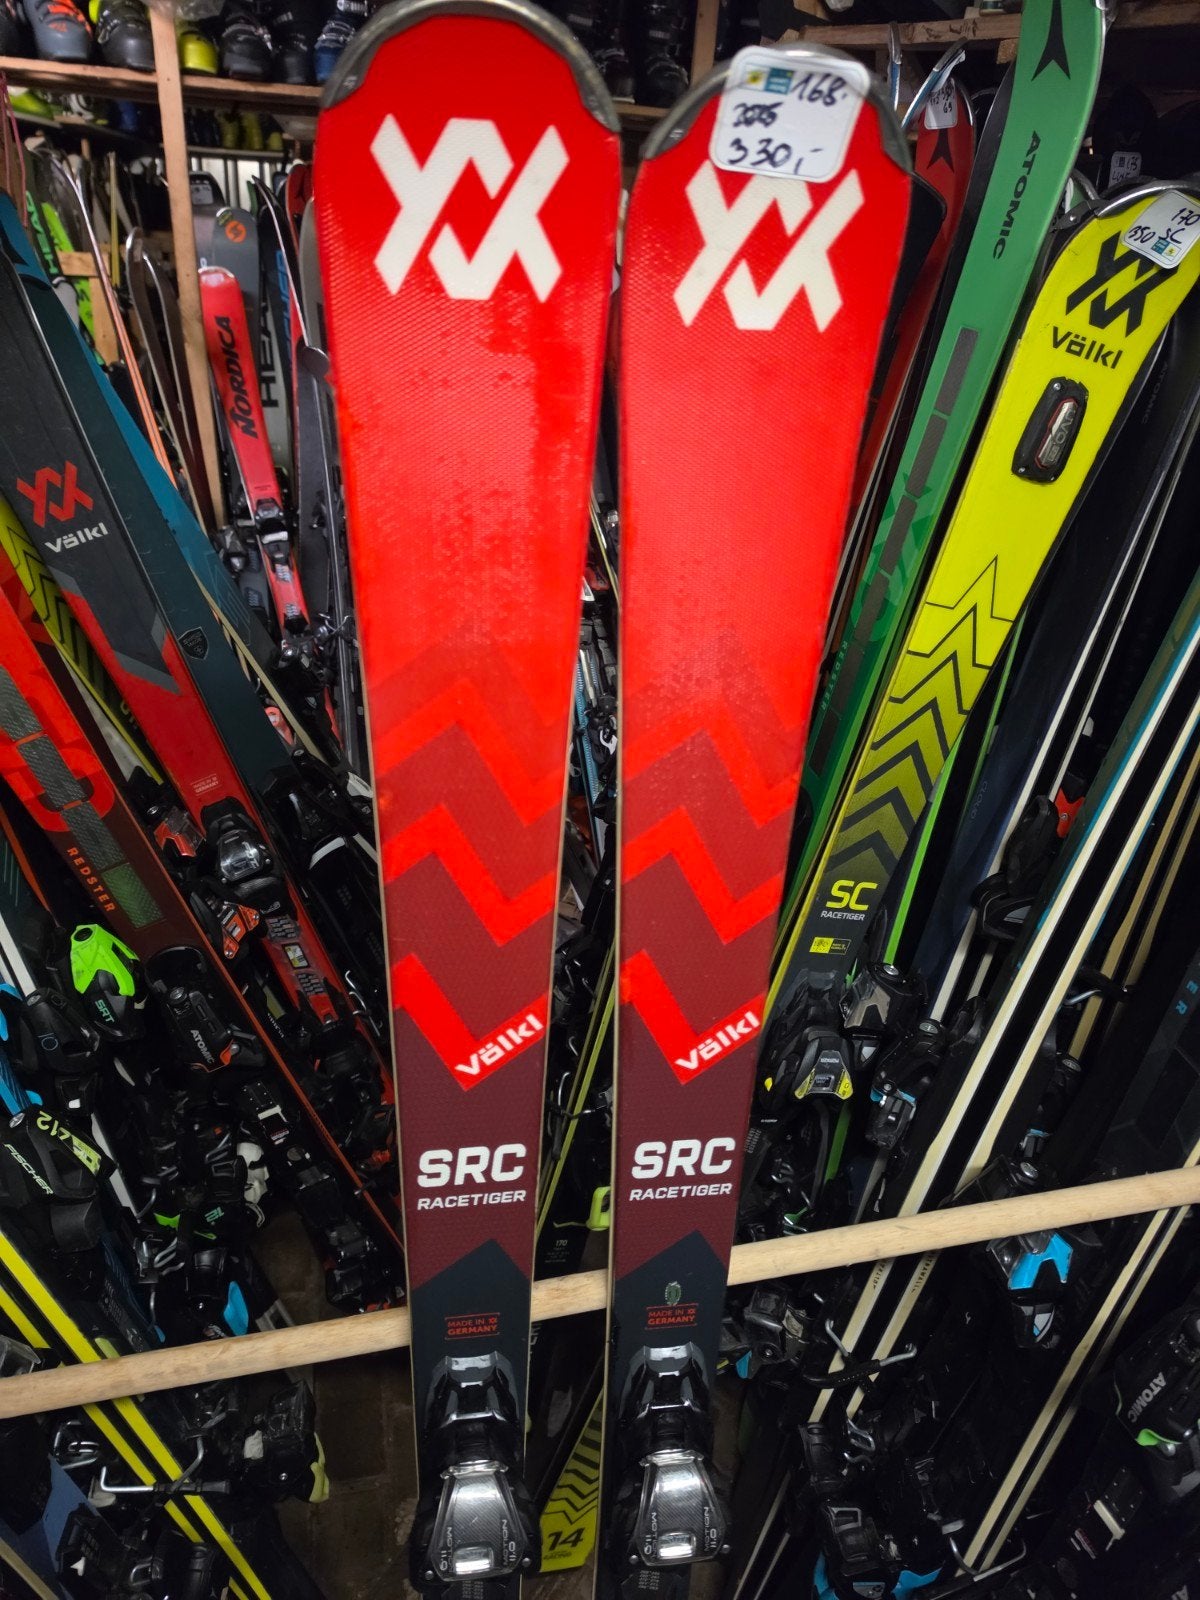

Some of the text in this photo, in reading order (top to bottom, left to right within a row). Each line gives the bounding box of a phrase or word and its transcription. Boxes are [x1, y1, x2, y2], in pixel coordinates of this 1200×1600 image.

[792, 73, 847, 106] 168
[993, 130, 1041, 260] ATOMIC
[1053, 325, 1124, 370] Völkl
[214, 315, 259, 440] NORDICA
[44, 521, 110, 553] Völkl
[820, 640, 849, 711] REDSTER
[67, 847, 116, 912] REDSTER
[825, 879, 878, 911] SC
[820, 910, 866, 921] RACETIGER
[94, 999, 115, 1024] SRT
[190, 1029, 216, 1064] ATOMIC
[454, 1013, 544, 1076] Völkl
[674, 1010, 761, 1070] Völkl
[4, 1143, 54, 1195] FISCHER
[417, 1143, 527, 1188] SRC
[631, 1137, 736, 1180] SRC
[417, 1190, 527, 1211] RACETIGER
[629, 1183, 733, 1202] RACETIGER
[447, 1320, 473, 1329] MADE
[447, 1325, 498, 1336] GERMANY
[647, 1315, 696, 1325] GERMANY
[648, 1310, 673, 1318] MADE
[1128, 1371, 1167, 1424] ATOMIC
[501, 1518, 509, 1567] MOTION
[508, 1540, 517, 1562] 11.0
[547, 1526, 586, 1551] 14
[709, 1528, 717, 1548] 11.0
